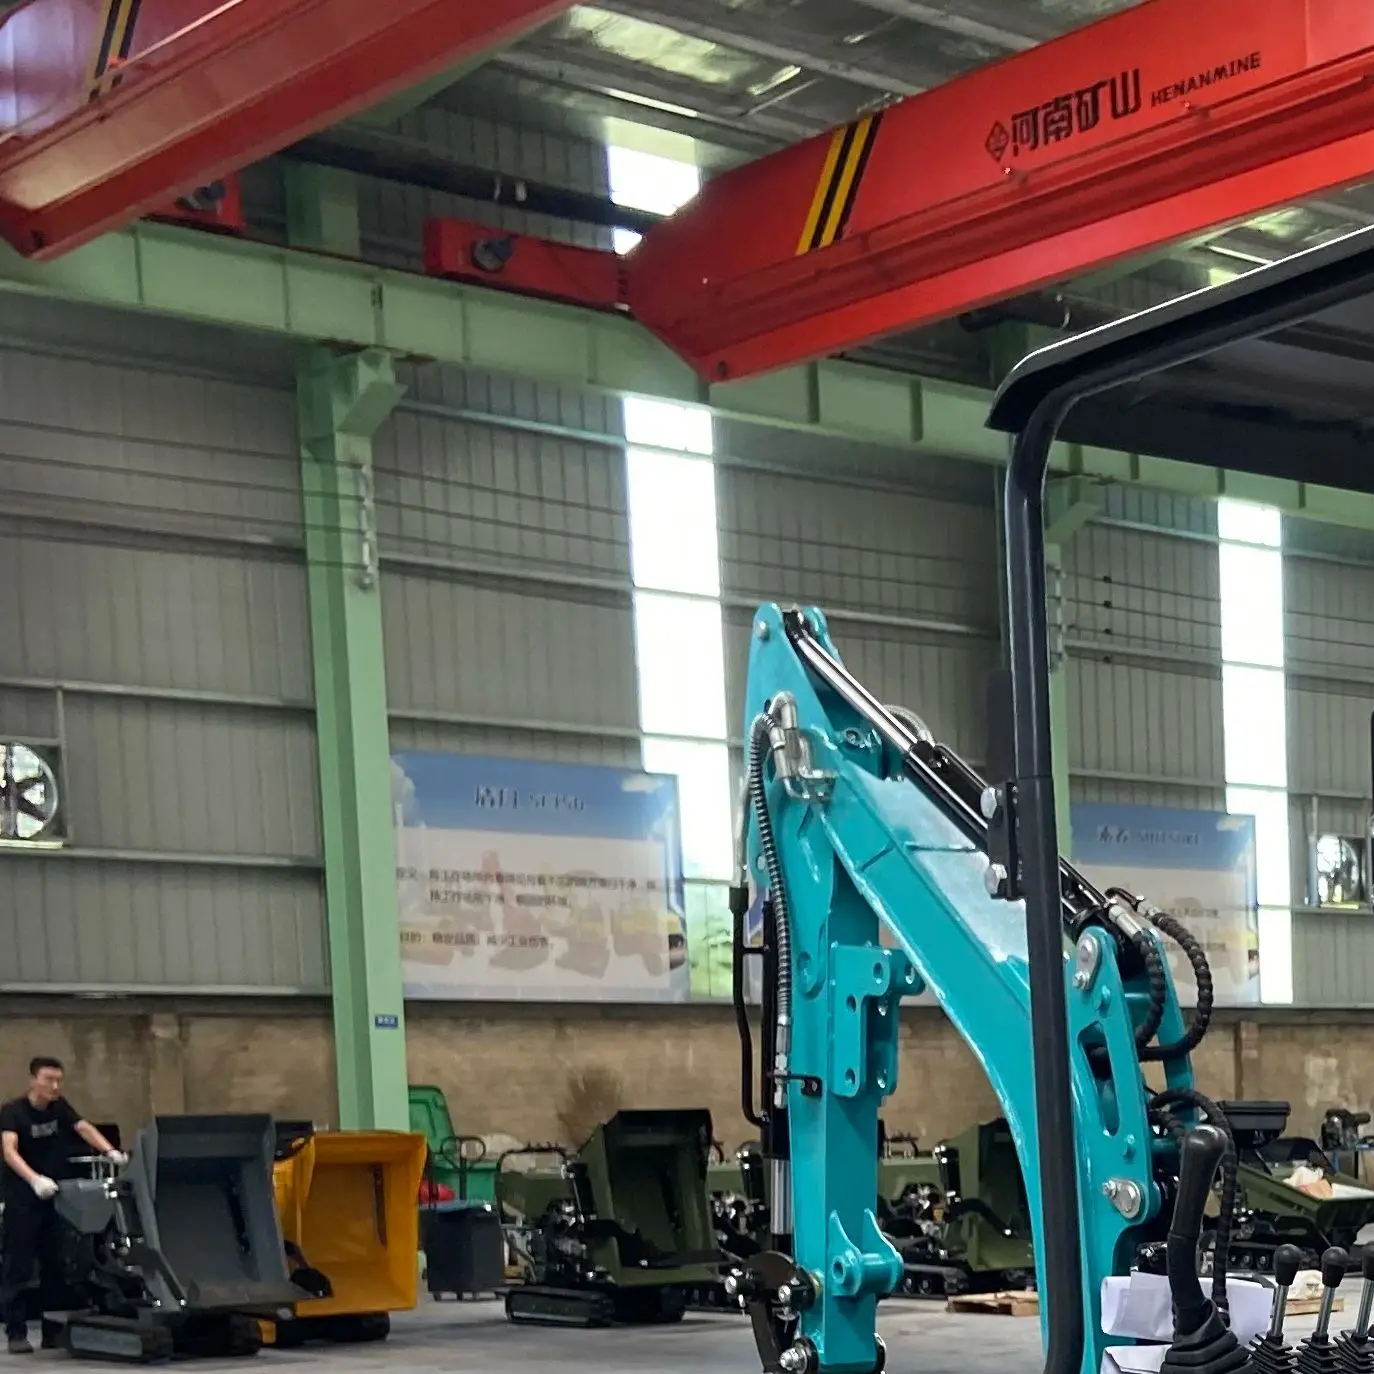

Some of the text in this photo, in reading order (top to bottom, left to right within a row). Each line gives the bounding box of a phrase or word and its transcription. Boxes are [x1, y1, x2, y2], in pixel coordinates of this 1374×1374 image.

[1011, 51, 1262, 157] 河南矿山 HENANMINE
